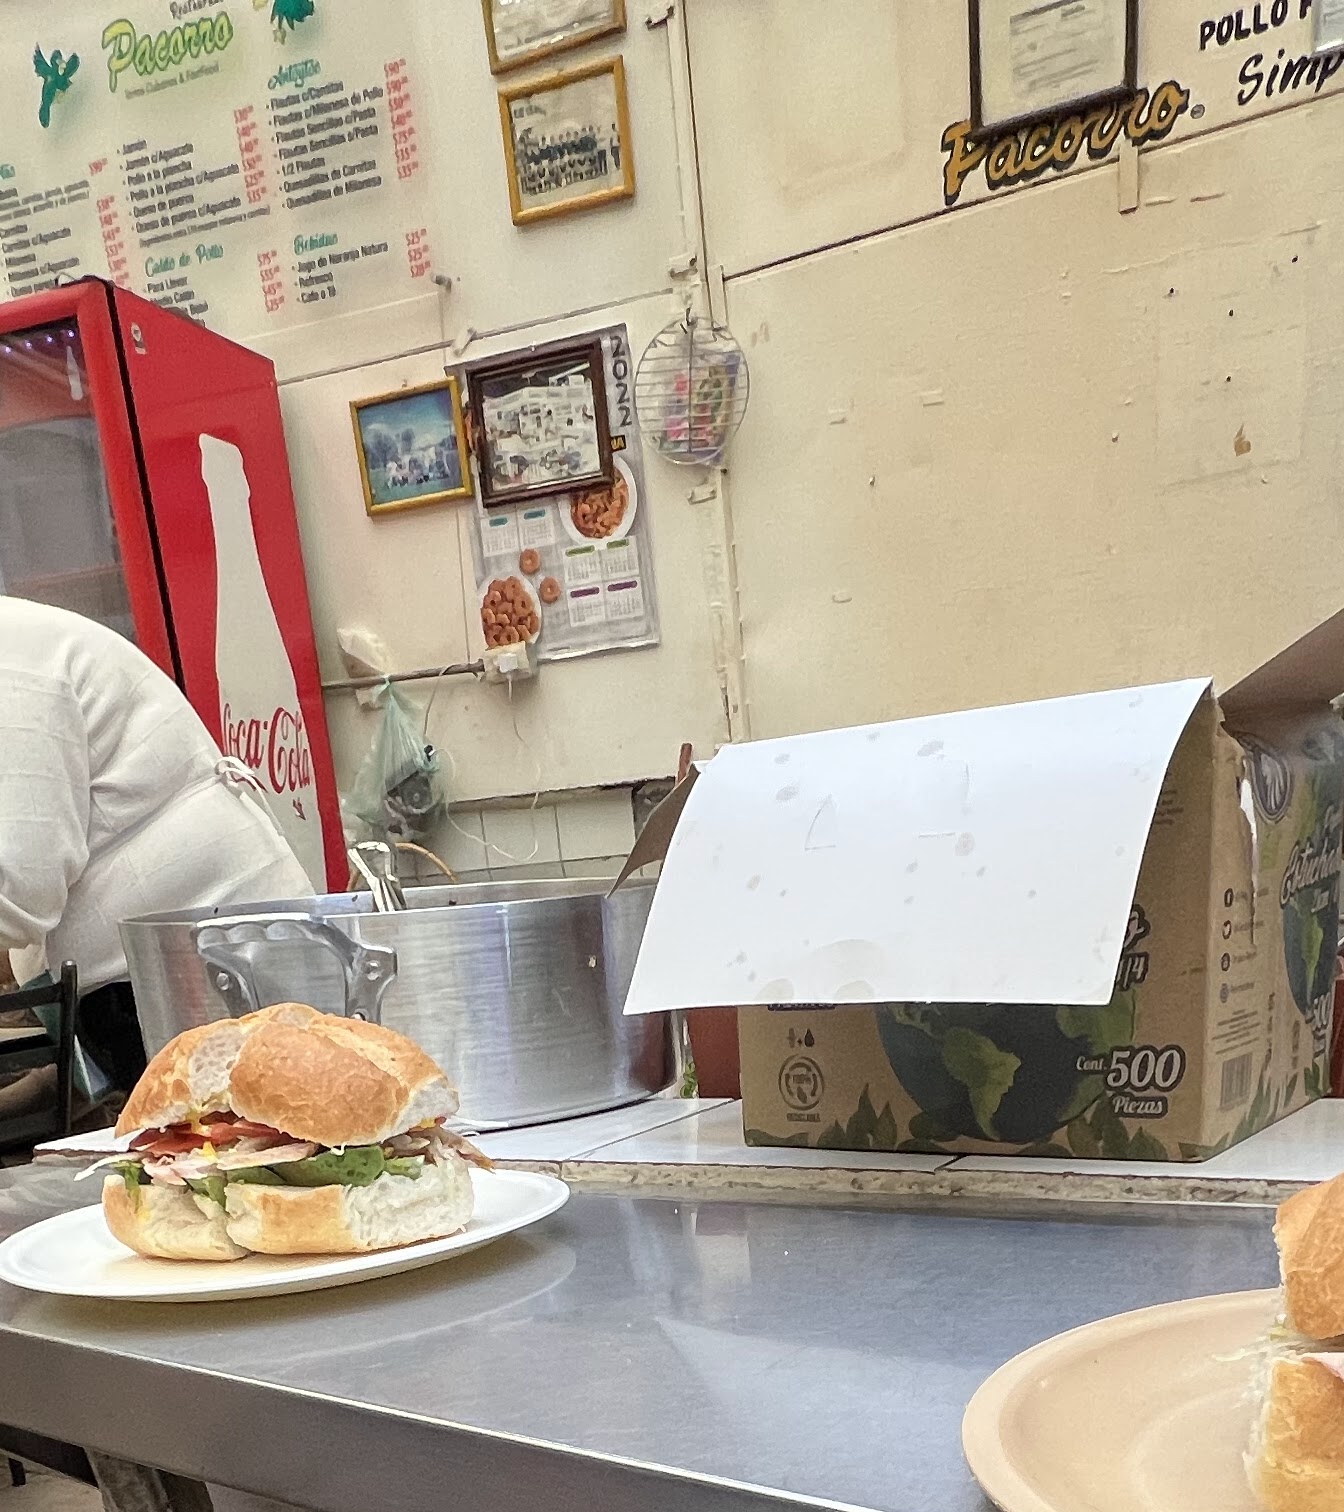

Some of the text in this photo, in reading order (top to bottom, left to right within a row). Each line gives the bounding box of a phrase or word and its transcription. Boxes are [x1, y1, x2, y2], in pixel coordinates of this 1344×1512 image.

[1200, 0, 1288, 51] POLLO
[102, 11, 233, 92] Pacorro
[294, 233, 338, 255] Bebidas
[611, 335, 633, 428] 2022
[1076, 1056, 1106, 1071] Cont.
[1107, 1049, 1181, 1088] 500
[1112, 1097, 1163, 1115] Piezas
